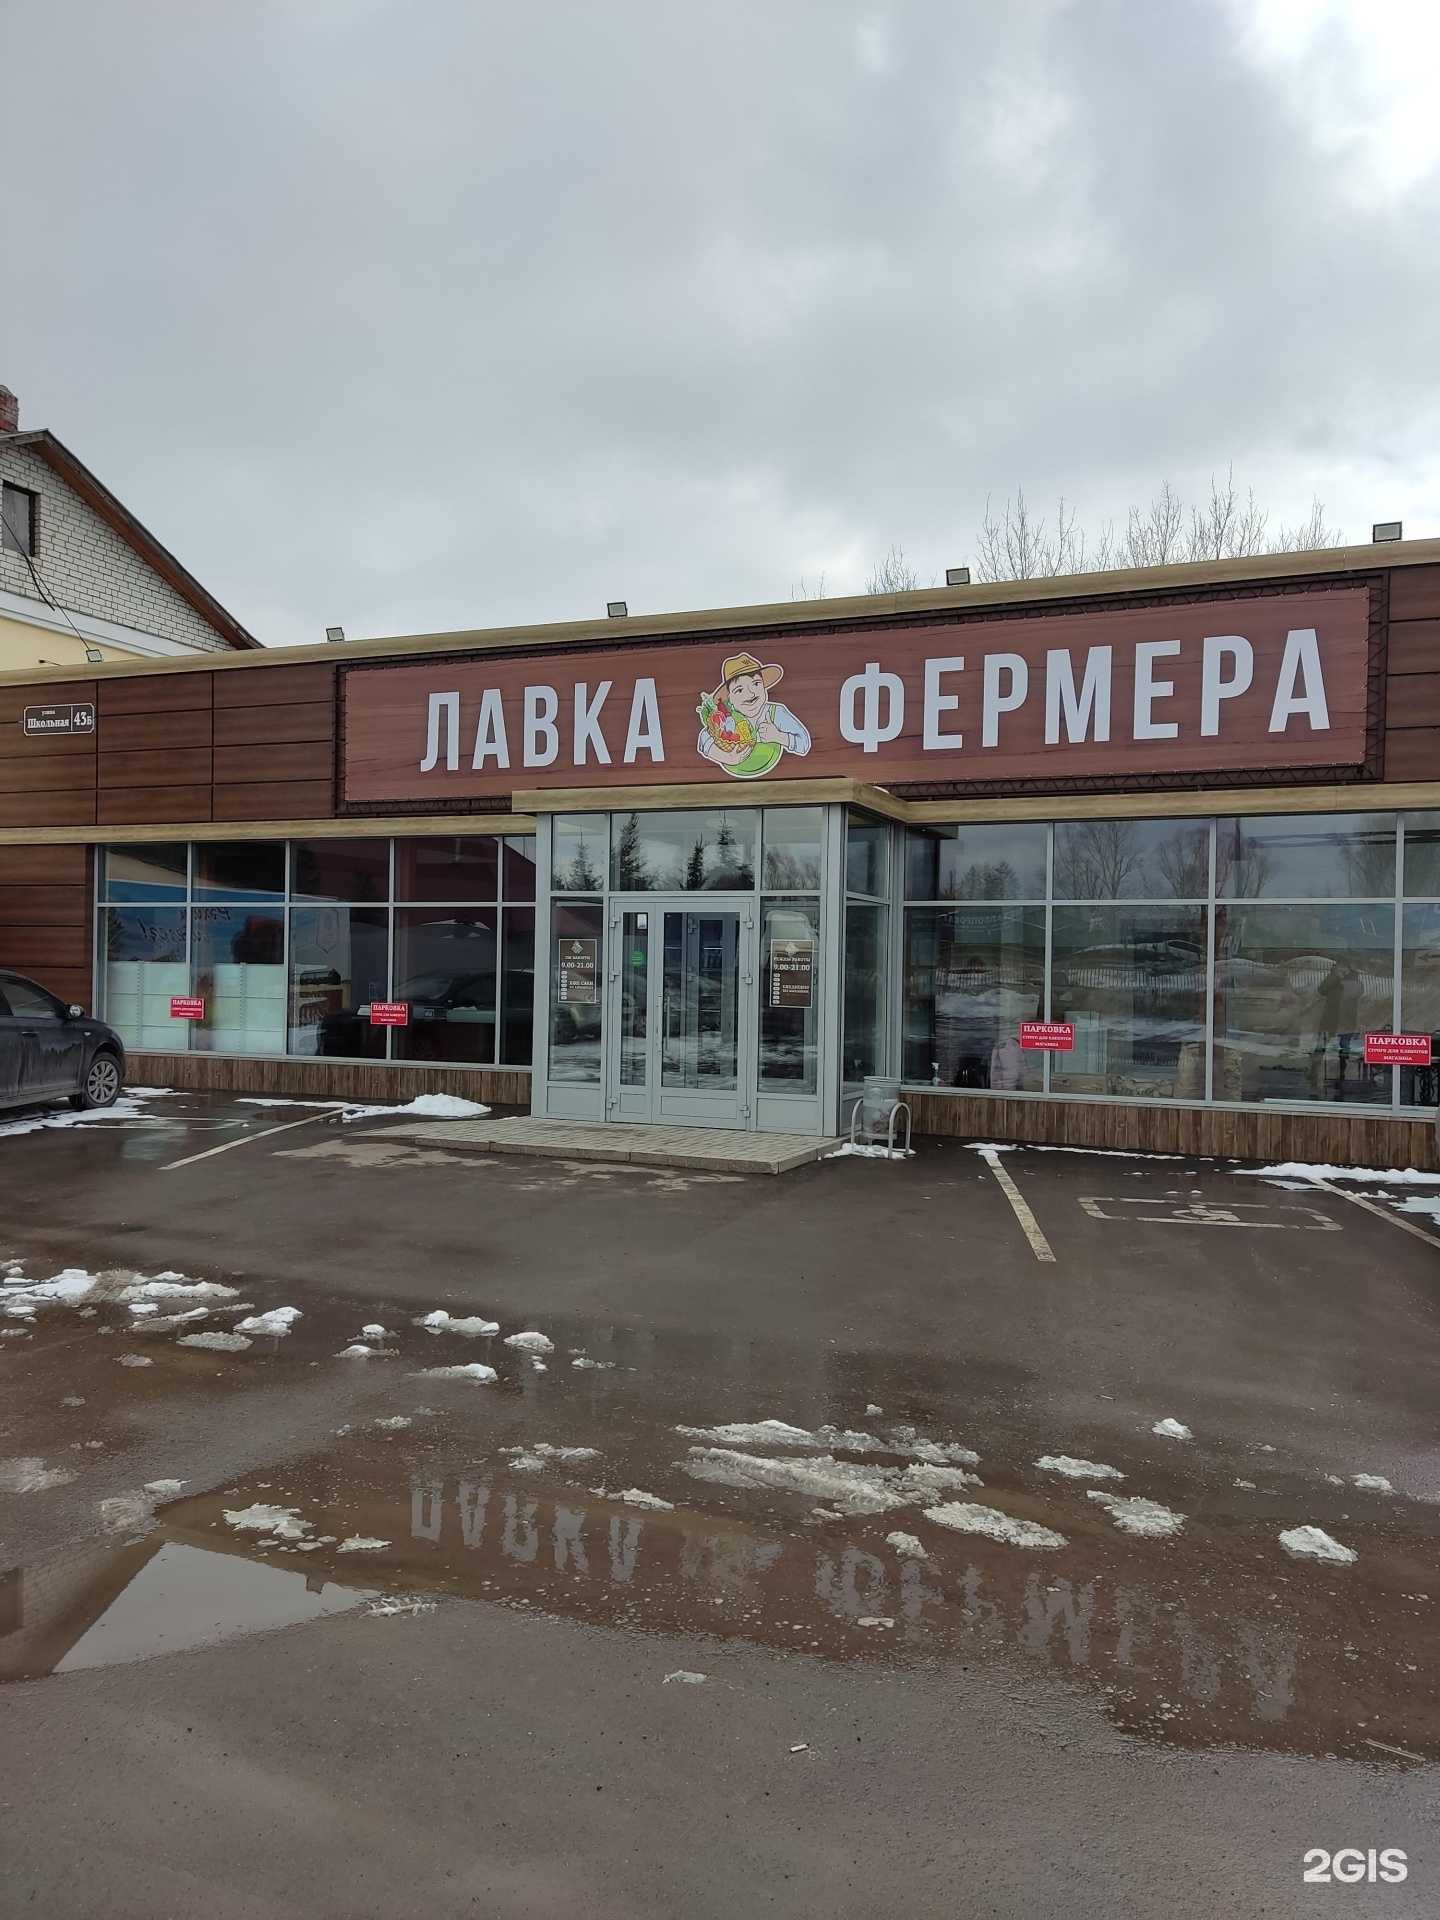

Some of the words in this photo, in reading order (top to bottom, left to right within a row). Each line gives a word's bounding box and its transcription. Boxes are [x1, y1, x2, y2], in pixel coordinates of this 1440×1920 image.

[420, 678, 665, 772] ЛАВКА
[839, 628, 1330, 753] ФЕРМЕРА
[27, 718, 70, 728] Школьная
[1023, 1025, 1071, 1034] ПАРКОВКА
[1368, 1036, 1427, 1046] ПАРКОВКА
